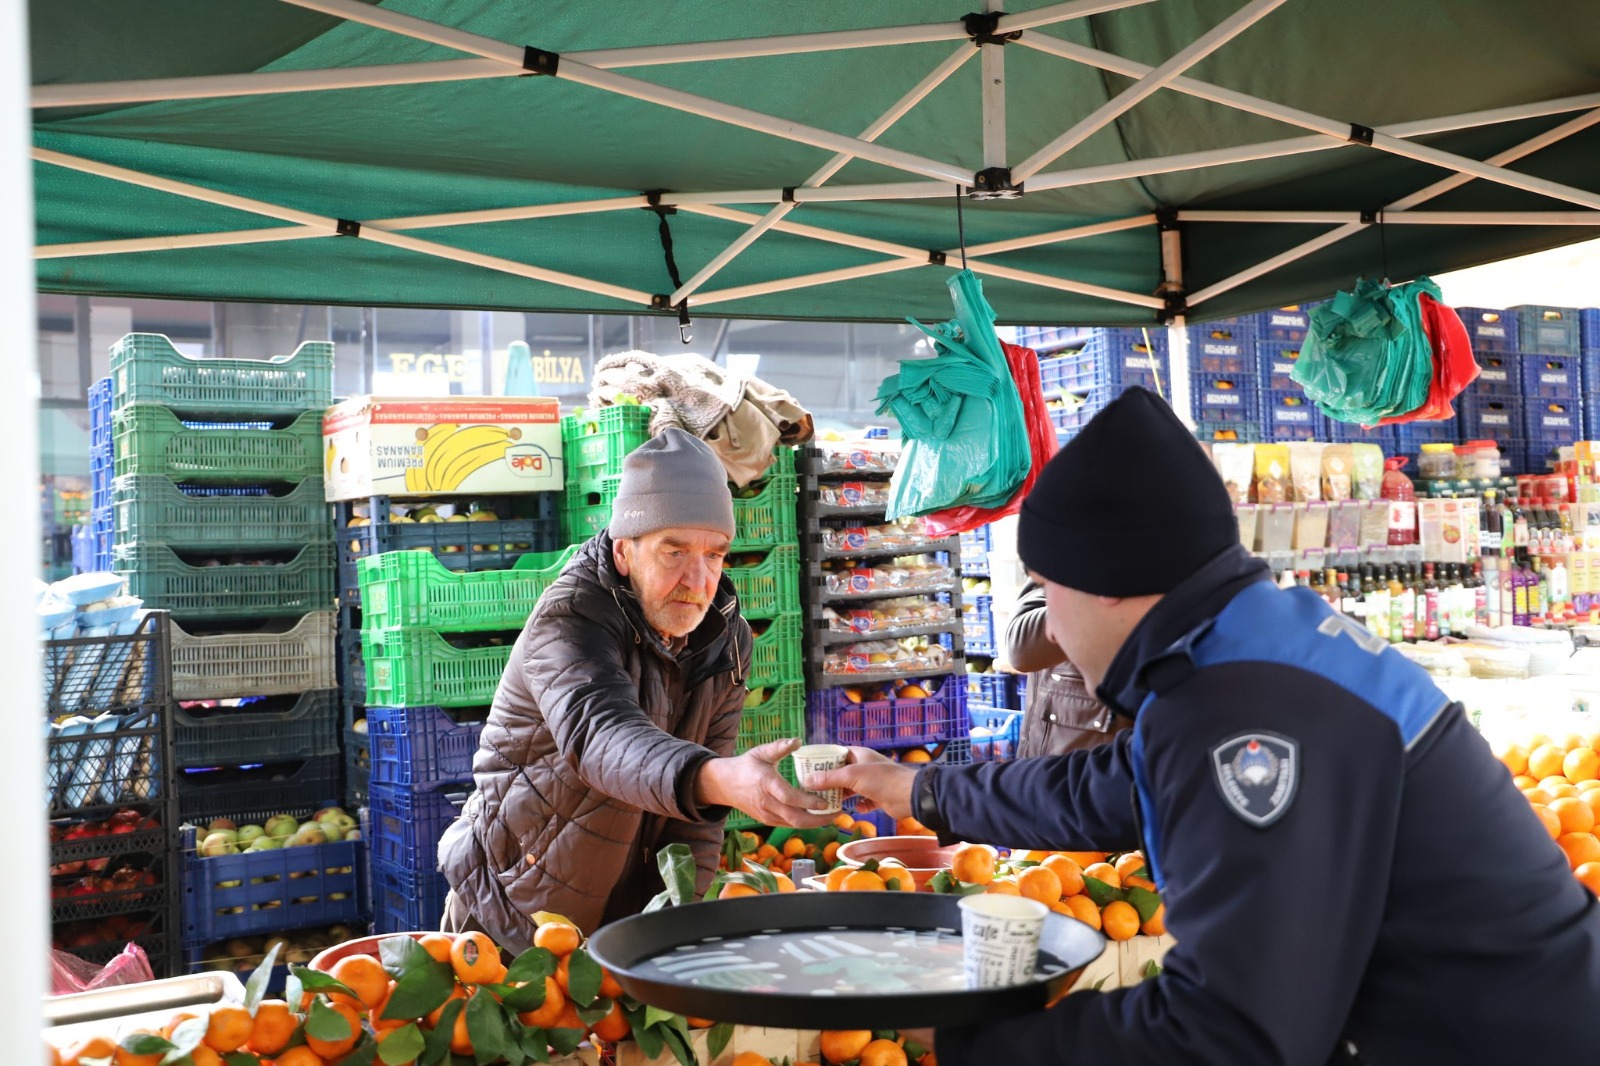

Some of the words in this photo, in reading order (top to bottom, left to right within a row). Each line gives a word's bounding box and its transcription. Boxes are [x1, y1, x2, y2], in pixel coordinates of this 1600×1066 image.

[389, 353, 469, 382] EGE
[500, 349, 585, 384] BİLYA
[376, 445, 424, 456] BANANAS
[377, 457, 424, 468] PREMIUM
[511, 456, 542, 472] Dole
[814, 761, 834, 771] cafe
[973, 924, 998, 941] cafe
